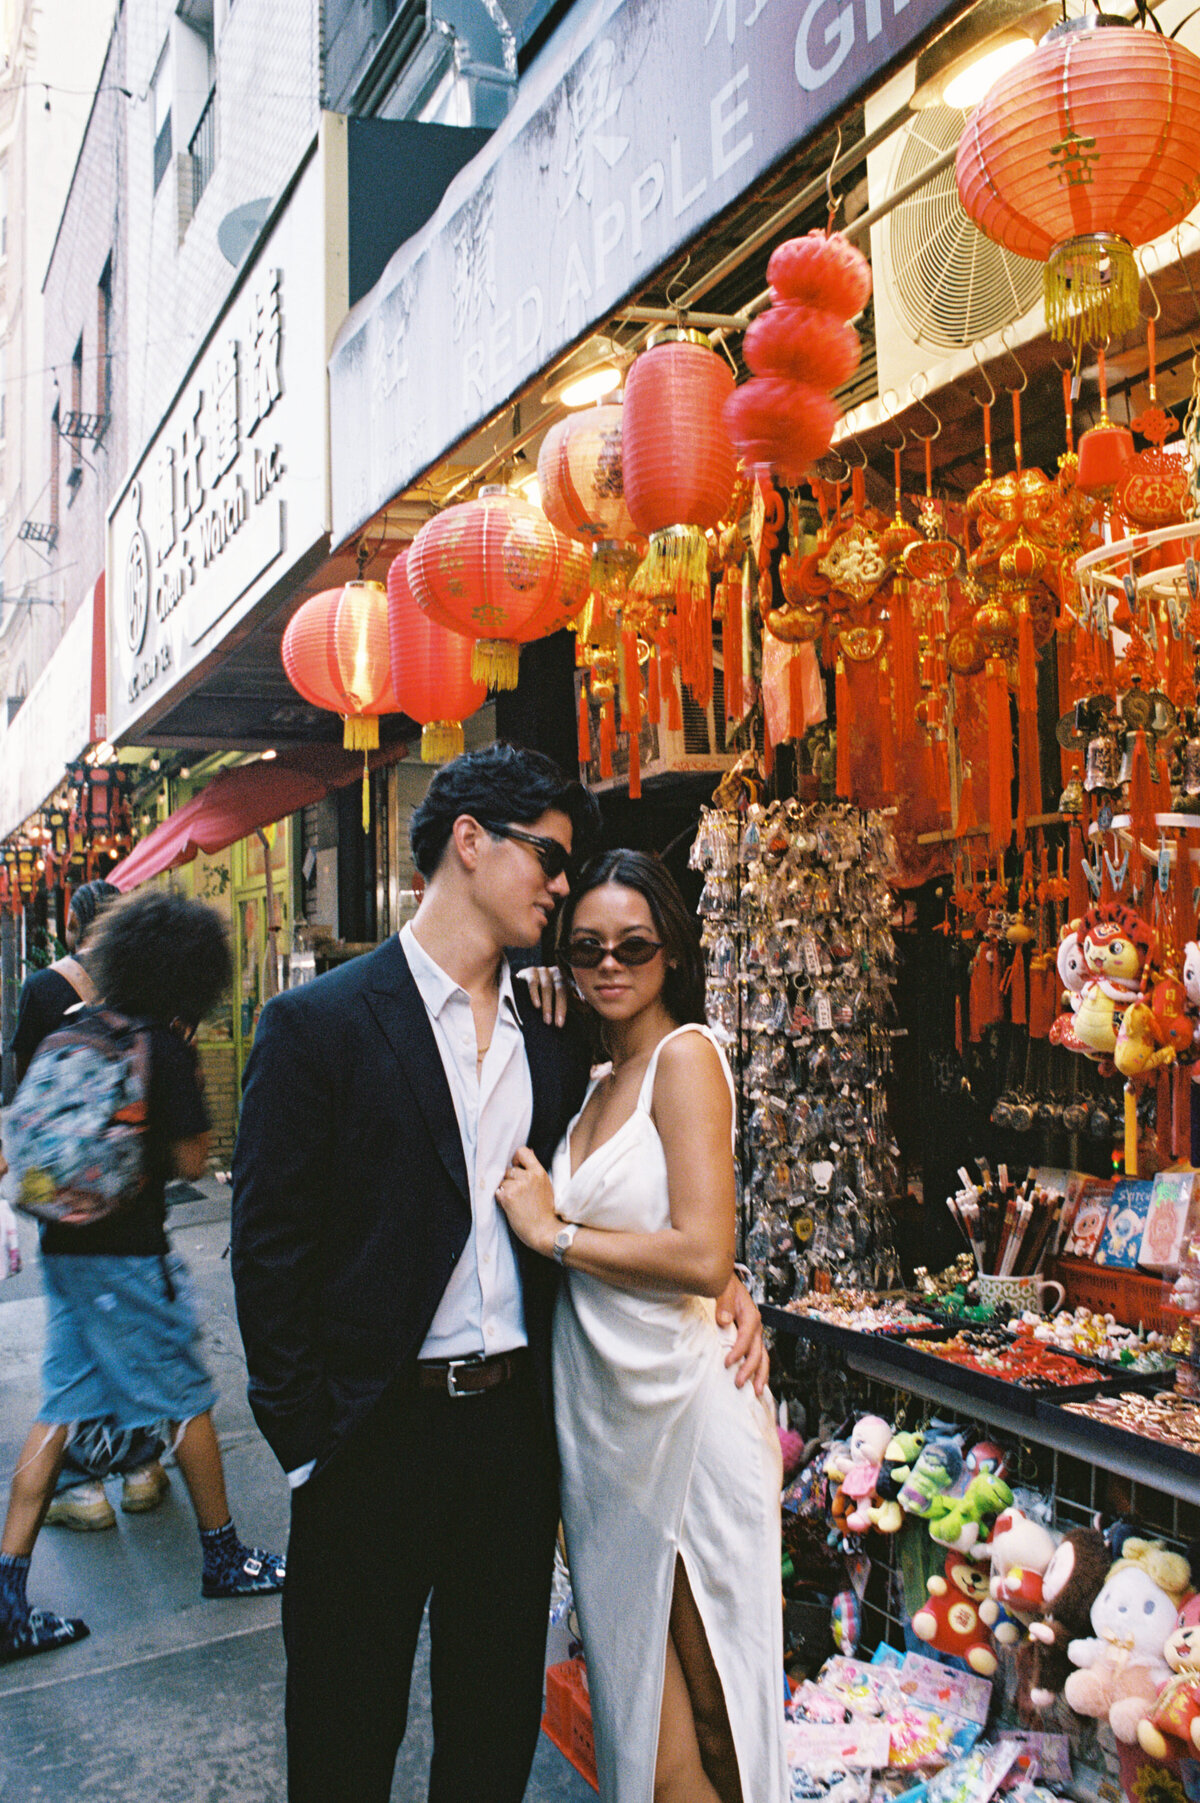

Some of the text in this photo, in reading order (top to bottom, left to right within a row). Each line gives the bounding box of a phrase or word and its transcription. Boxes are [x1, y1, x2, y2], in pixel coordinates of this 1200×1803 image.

[464, 284, 542, 396] RED
[558, 64, 754, 335] APPLE
[201, 473, 250, 570] Watch
[255, 443, 287, 505] Inc.
